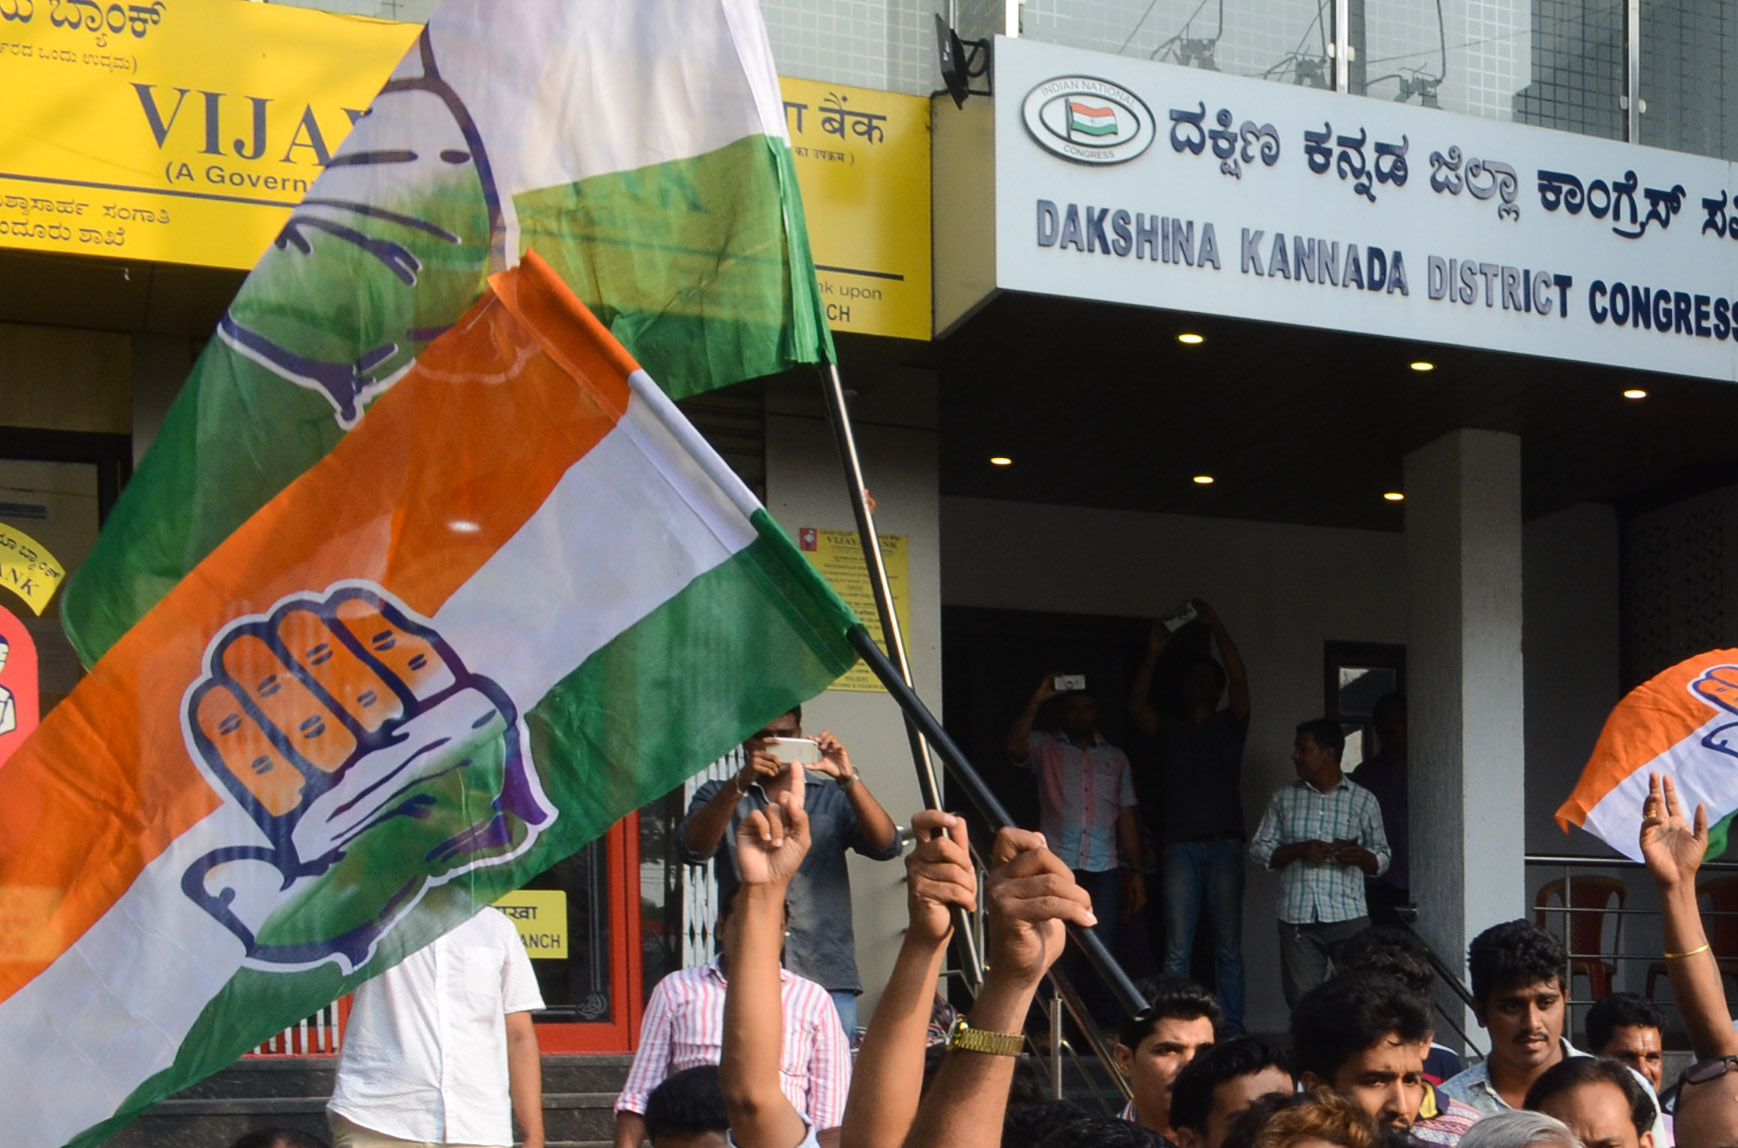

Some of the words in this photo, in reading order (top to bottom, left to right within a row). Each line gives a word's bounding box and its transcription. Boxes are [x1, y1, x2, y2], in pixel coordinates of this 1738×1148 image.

[38, 47, 77, 63] ಒಂದು
[1041, 81, 1079, 97] INDIAN
[1082, 80, 1136, 108] NATIONAL
[819, 91, 887, 144] बैंक
[1063, 144, 1115, 159] CONGRESS
[165, 162, 195, 184] (A
[206, 165, 316, 193] Govern
[1169, 101, 1280, 180] ದಕ್ಷಿಣ
[1304, 121, 1409, 202] ಕನ್ನಡ
[1429, 145, 1520, 222] ಜಿಲ್ಲಾ
[1537, 170, 1687, 239] ಕಾಂಗ್ರೆಸ್
[103, 203, 171, 225] ಸಂಗಾತಿ
[79, 226, 126, 247] ಶಾಖೆ
[1036, 199, 1221, 270] DAKSHINA
[1241, 227, 1409, 296] KANNADA
[1427, 255, 1572, 318] DISTRICT
[839, 285, 882, 300] upon
[520, 933, 561, 949] ANCH
